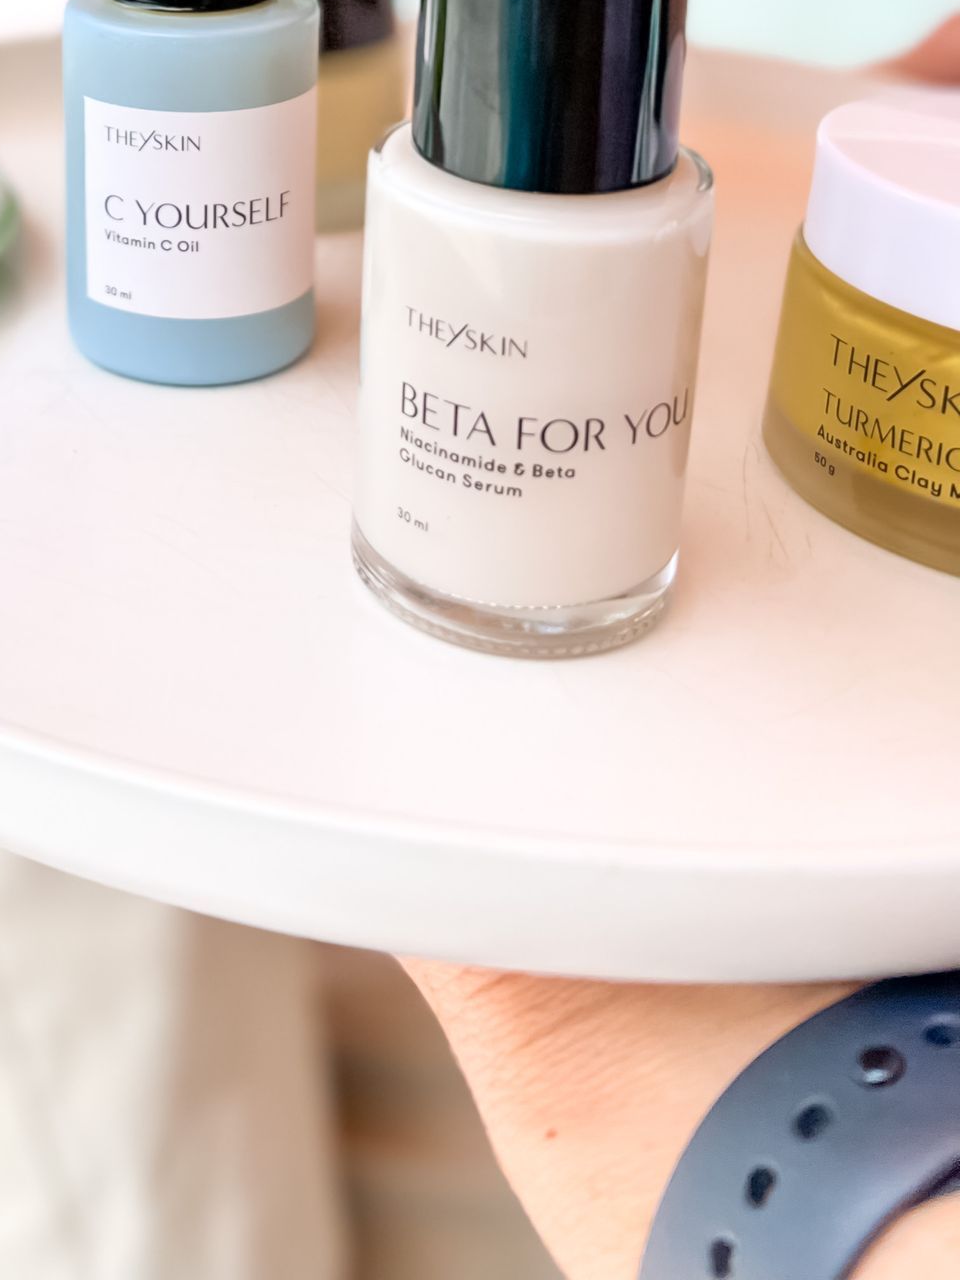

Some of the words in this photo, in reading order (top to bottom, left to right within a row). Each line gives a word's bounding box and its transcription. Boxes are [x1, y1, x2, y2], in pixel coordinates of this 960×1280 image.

[104, 194, 124, 221] C
[135, 190, 290, 230] YOURSELF
[104, 229, 156, 250] Vitamin
[160, 239, 172, 251] C
[177, 240, 199, 253] Oil
[105, 284, 117, 297] 30
[120, 290, 132, 300] ml
[400, 381, 497, 447] BETA
[516, 417, 605, 453] FOR
[624, 387, 689, 445] YOU
[399, 448, 456, 484] Glucan
[462, 473, 524, 498] Serum
[400, 426, 507, 475] Niacinamide
[513, 463, 525, 476] &
[532, 463, 576, 480] Beta
[814, 451, 827, 468] 50
[828, 464, 836, 476] g
[818, 424, 888, 472] Australia
[895, 464, 942, 496] Clay
[397, 507, 411, 522] 30
[414, 518, 429, 532] ml
